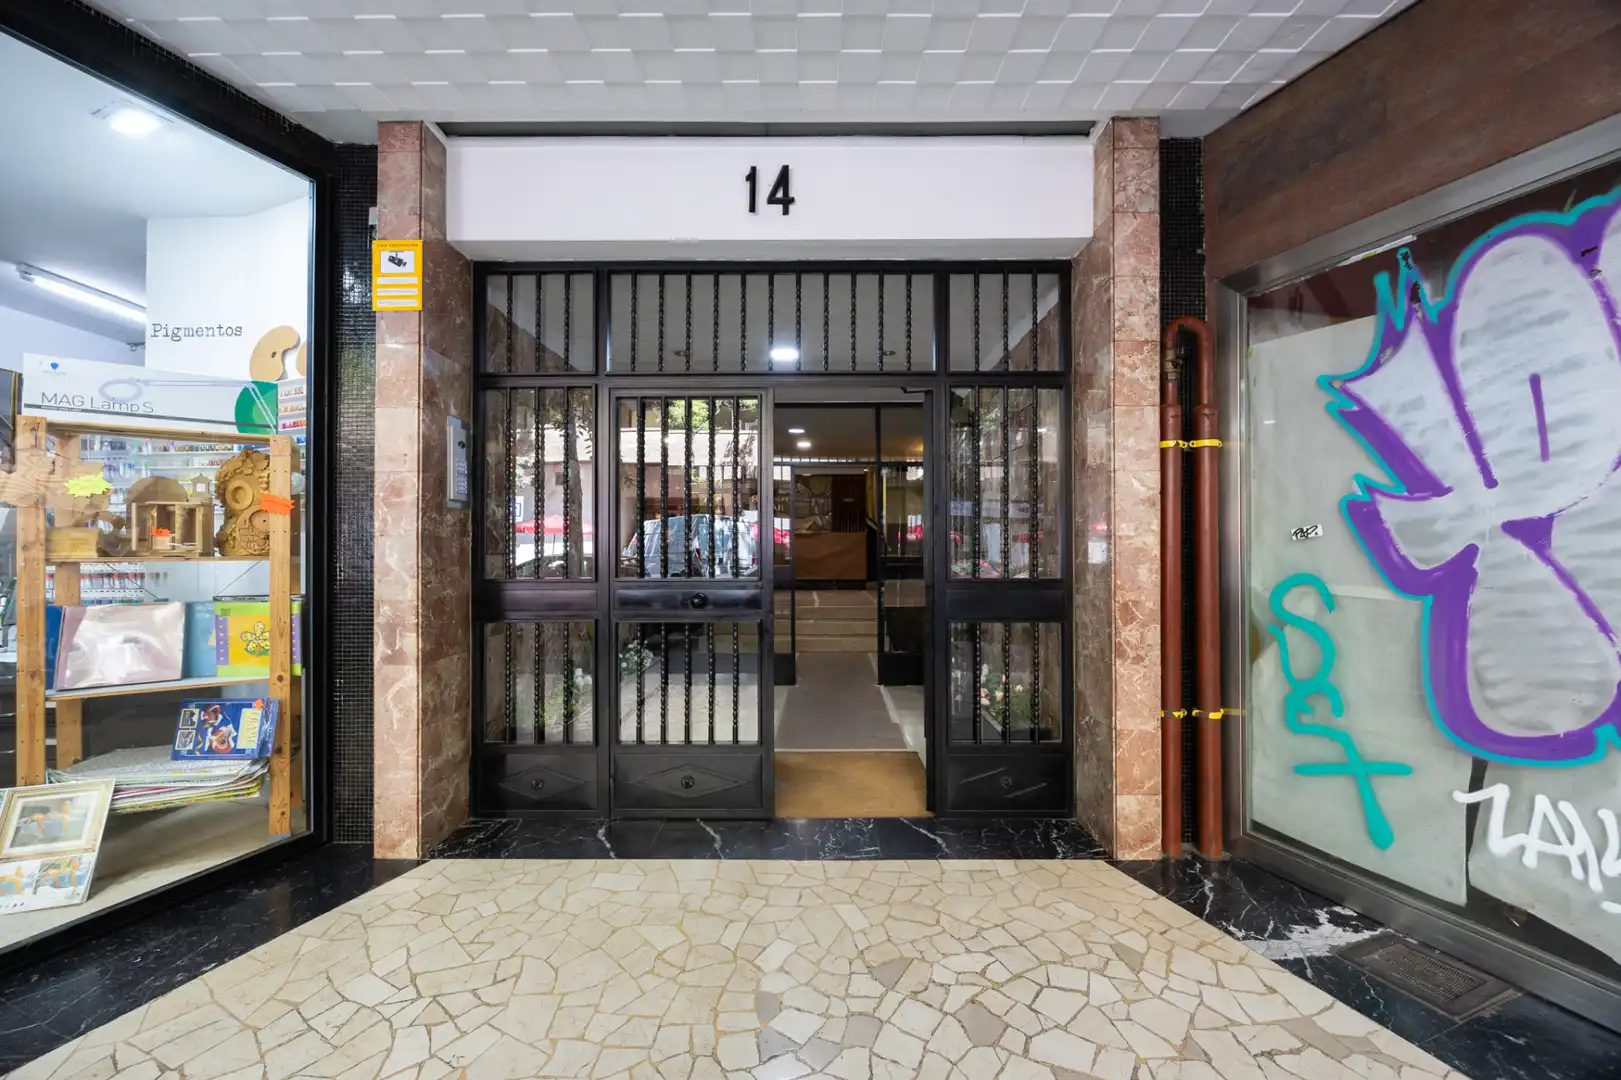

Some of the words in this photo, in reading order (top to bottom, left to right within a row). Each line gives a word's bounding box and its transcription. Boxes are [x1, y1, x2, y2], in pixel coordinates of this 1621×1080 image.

[745, 164, 796, 216] 14
[150, 323, 243, 342] Pigmentos
[41, 391, 85, 407] MAG
[90, 396, 140, 413] Lamp
